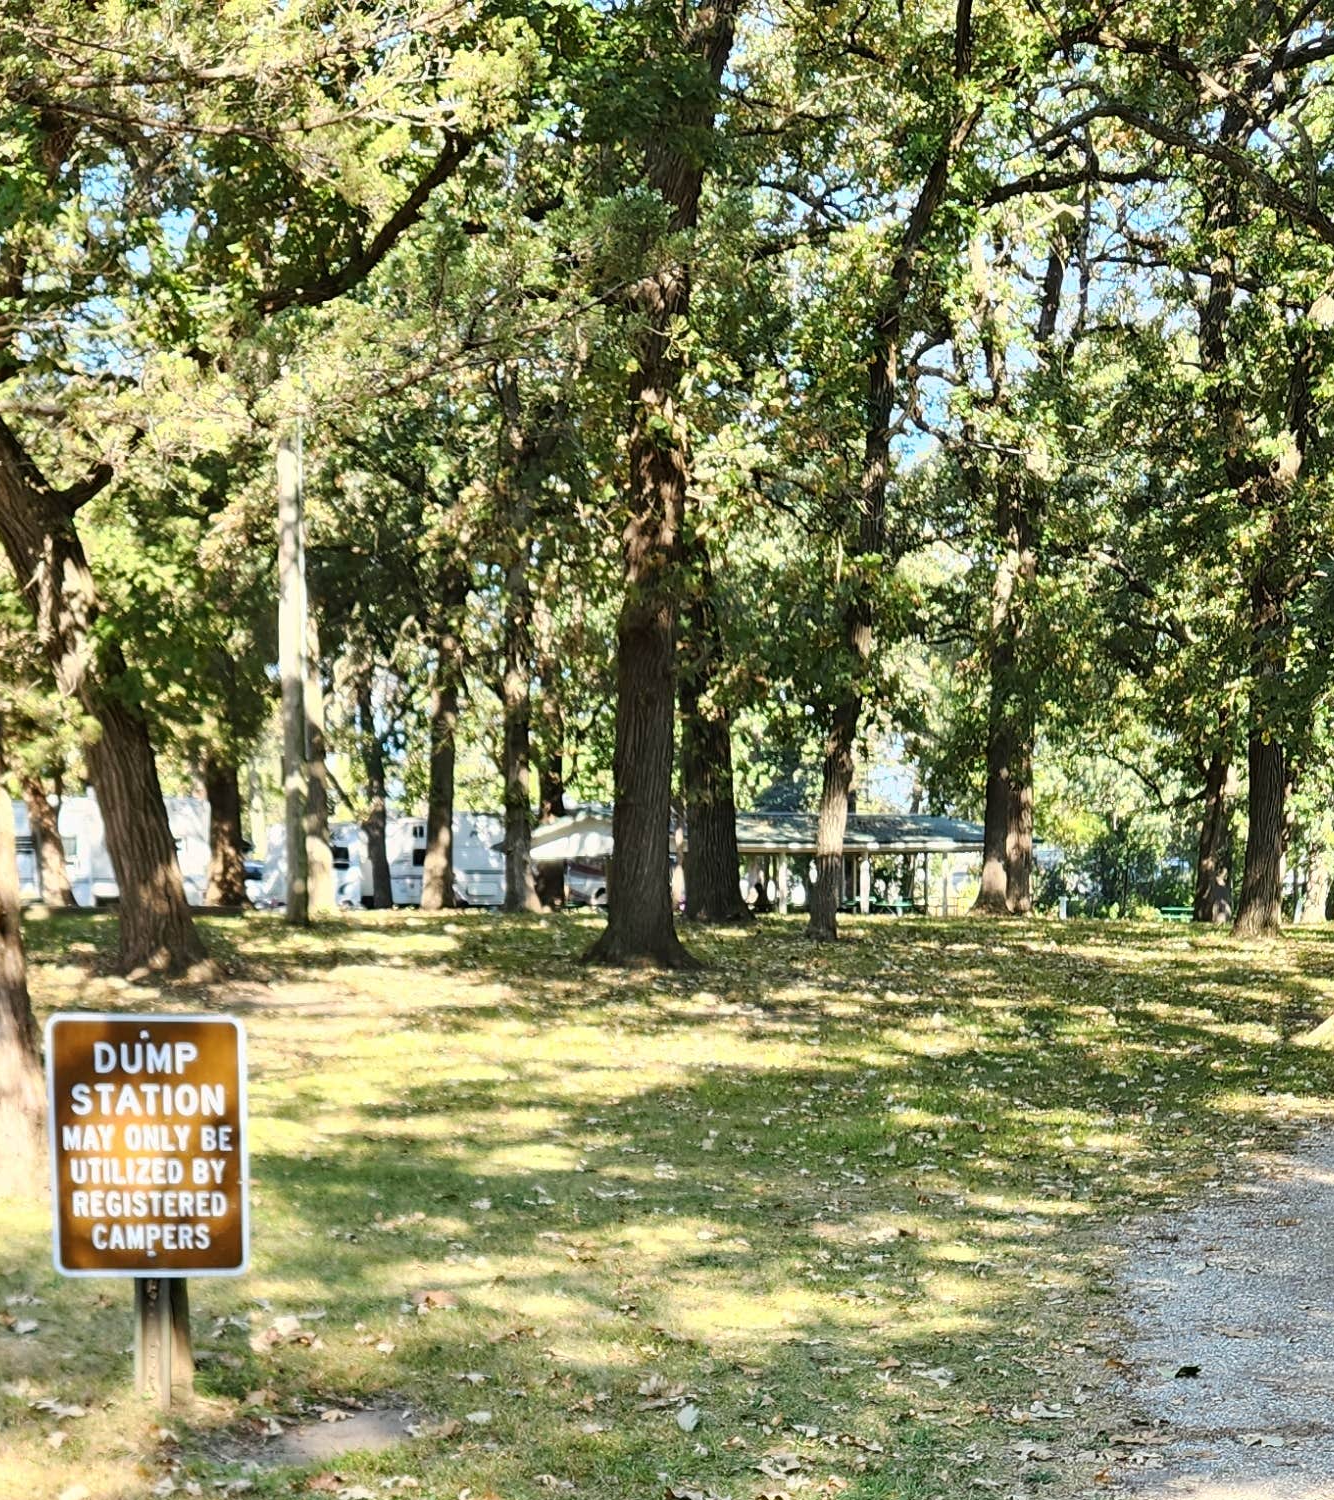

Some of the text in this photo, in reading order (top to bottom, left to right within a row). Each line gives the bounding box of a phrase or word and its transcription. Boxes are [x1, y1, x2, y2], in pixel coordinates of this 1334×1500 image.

[93, 1041, 198, 1075] DUMP
[70, 1083, 226, 1117] STATION
[62, 1125, 233, 1152] MAY ONLY BE
[70, 1157, 226, 1184] UTILIZED BY
[71, 1190, 227, 1218] REGISTERED
[92, 1223, 211, 1250] CAMPERS
